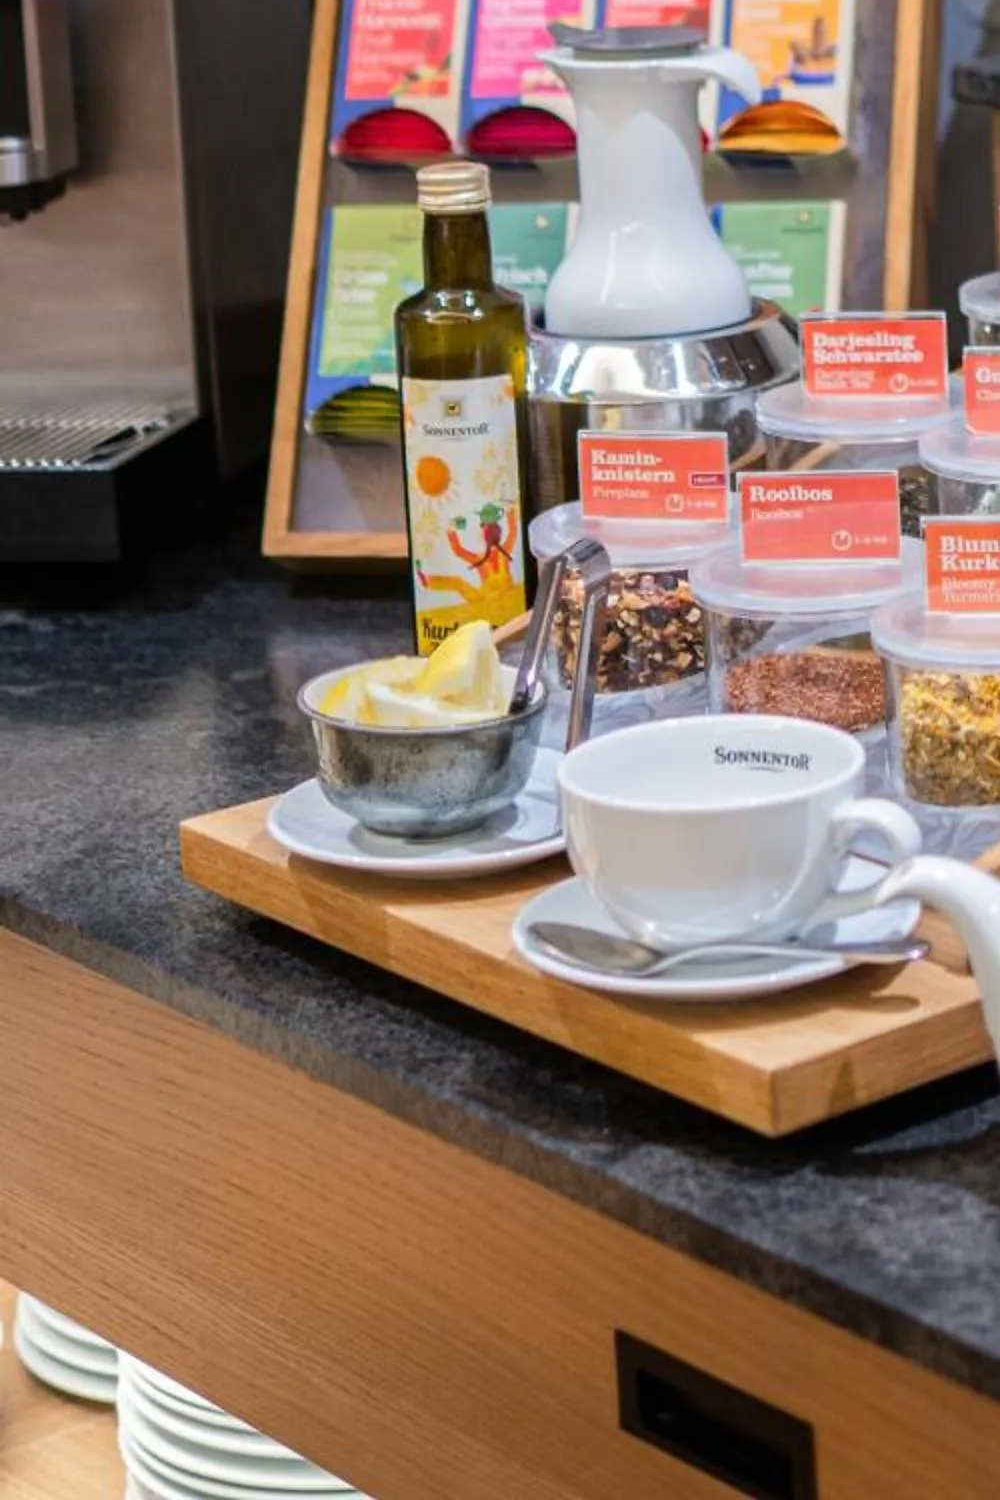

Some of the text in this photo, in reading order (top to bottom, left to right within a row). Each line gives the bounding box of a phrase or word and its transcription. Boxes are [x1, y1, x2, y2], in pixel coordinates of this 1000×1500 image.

[812, 332, 916, 350] Darjeeling
[813, 348, 925, 365] Schwarztee
[591, 450, 664, 467] Kamin-
[591, 466, 676, 484] knistern
[749, 485, 833, 502] Rooibos
[714, 745, 812, 771] SONNENTOR
